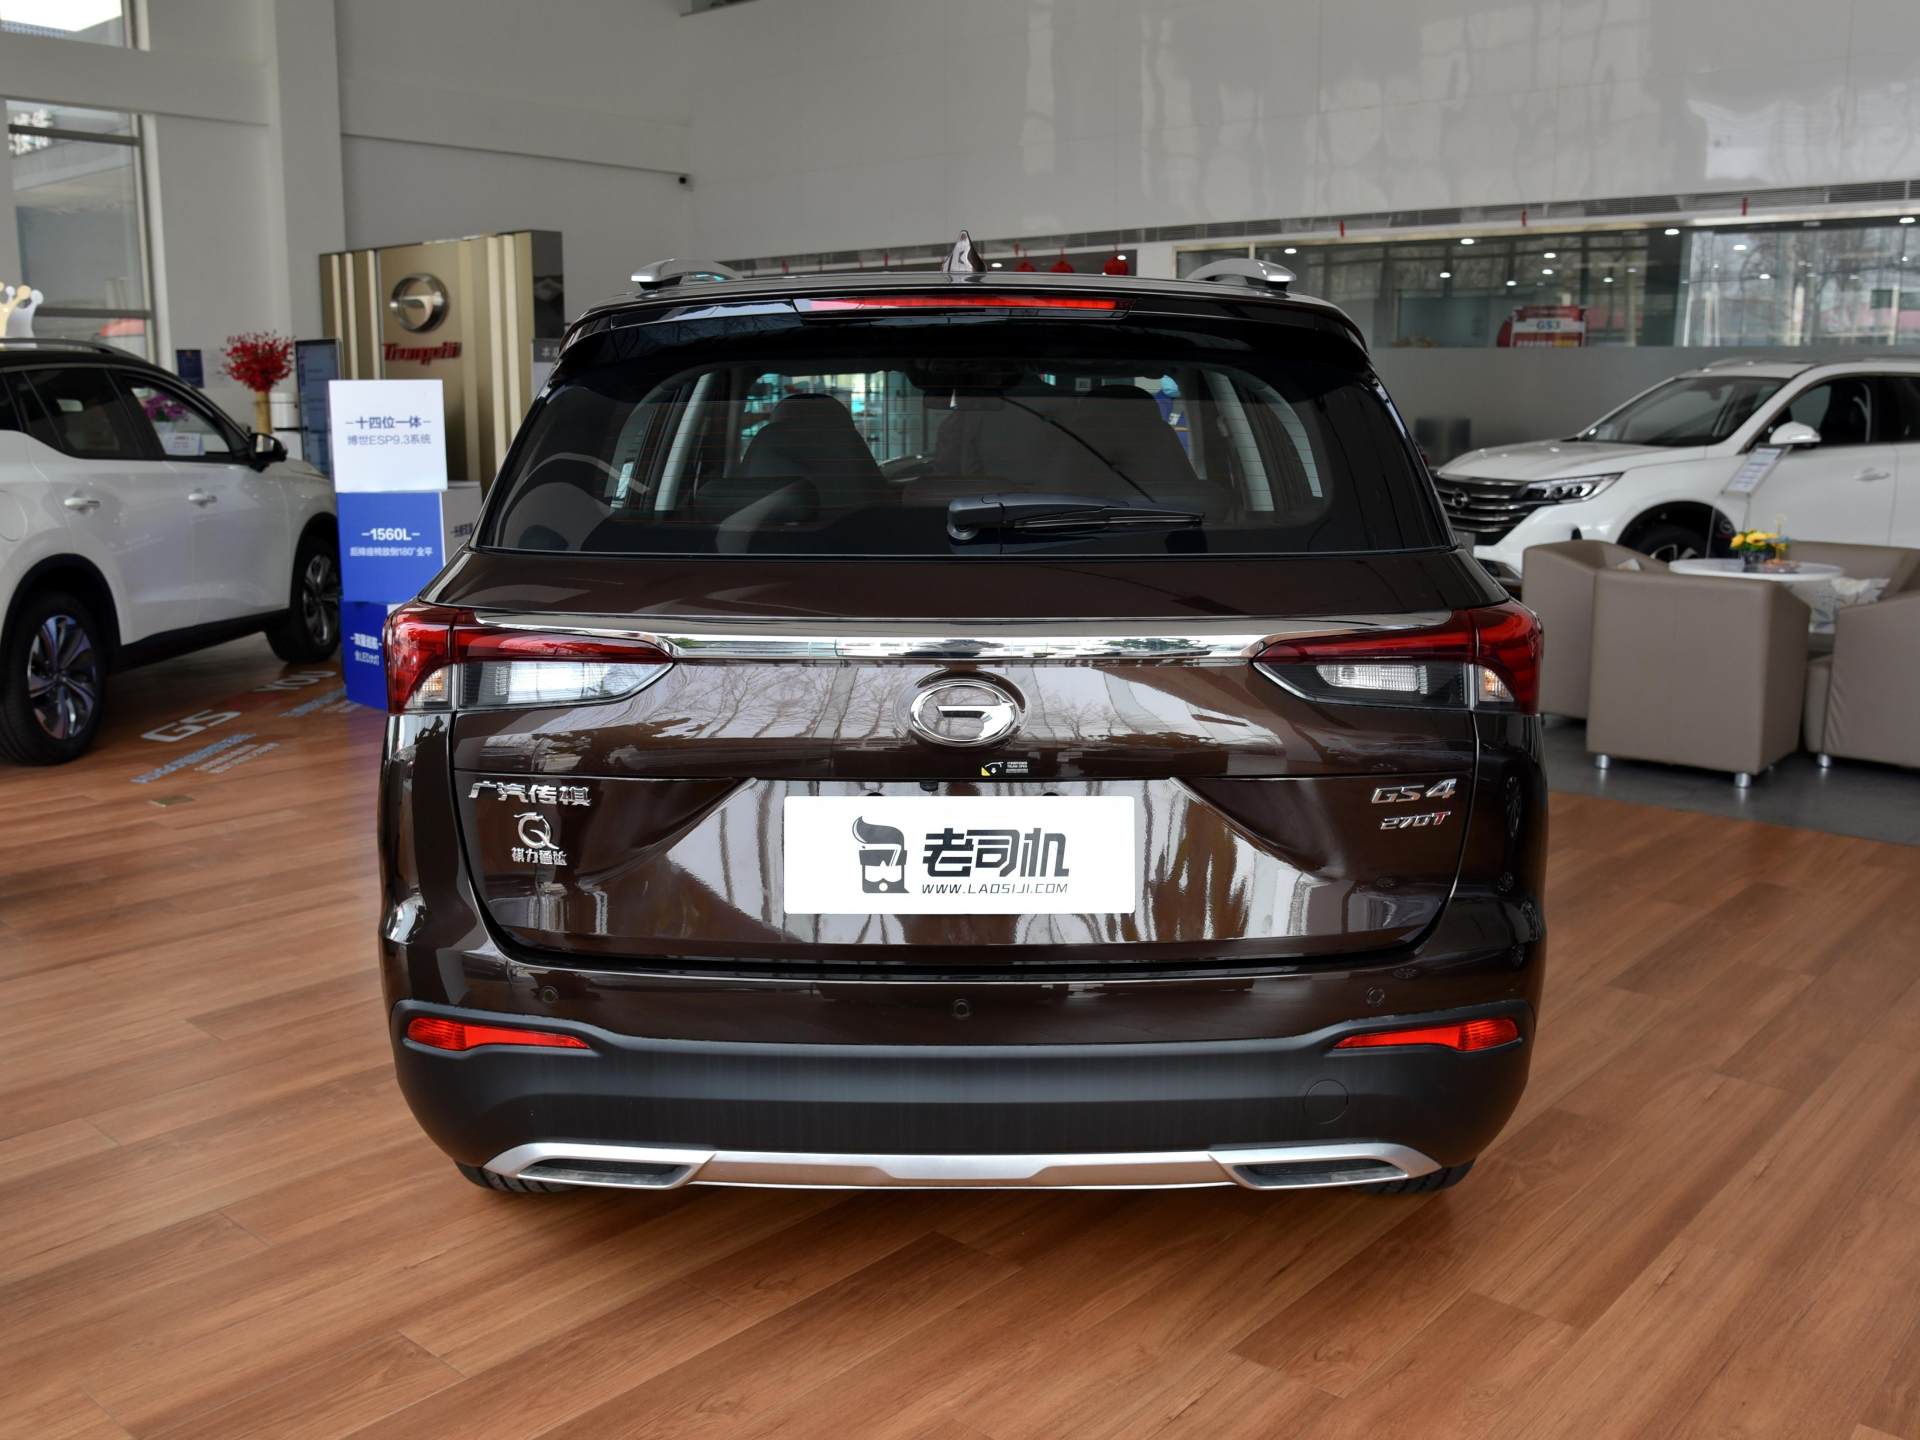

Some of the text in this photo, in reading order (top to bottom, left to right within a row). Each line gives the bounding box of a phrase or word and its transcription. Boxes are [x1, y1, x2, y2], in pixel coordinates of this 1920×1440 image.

[468, 780, 592, 807] 广汽传祺
[1380, 811, 1451, 830] 270T
[922, 827, 1070, 878] 老司机
[921, 883, 1068, 895] WWW.LAOSIJI.COM
